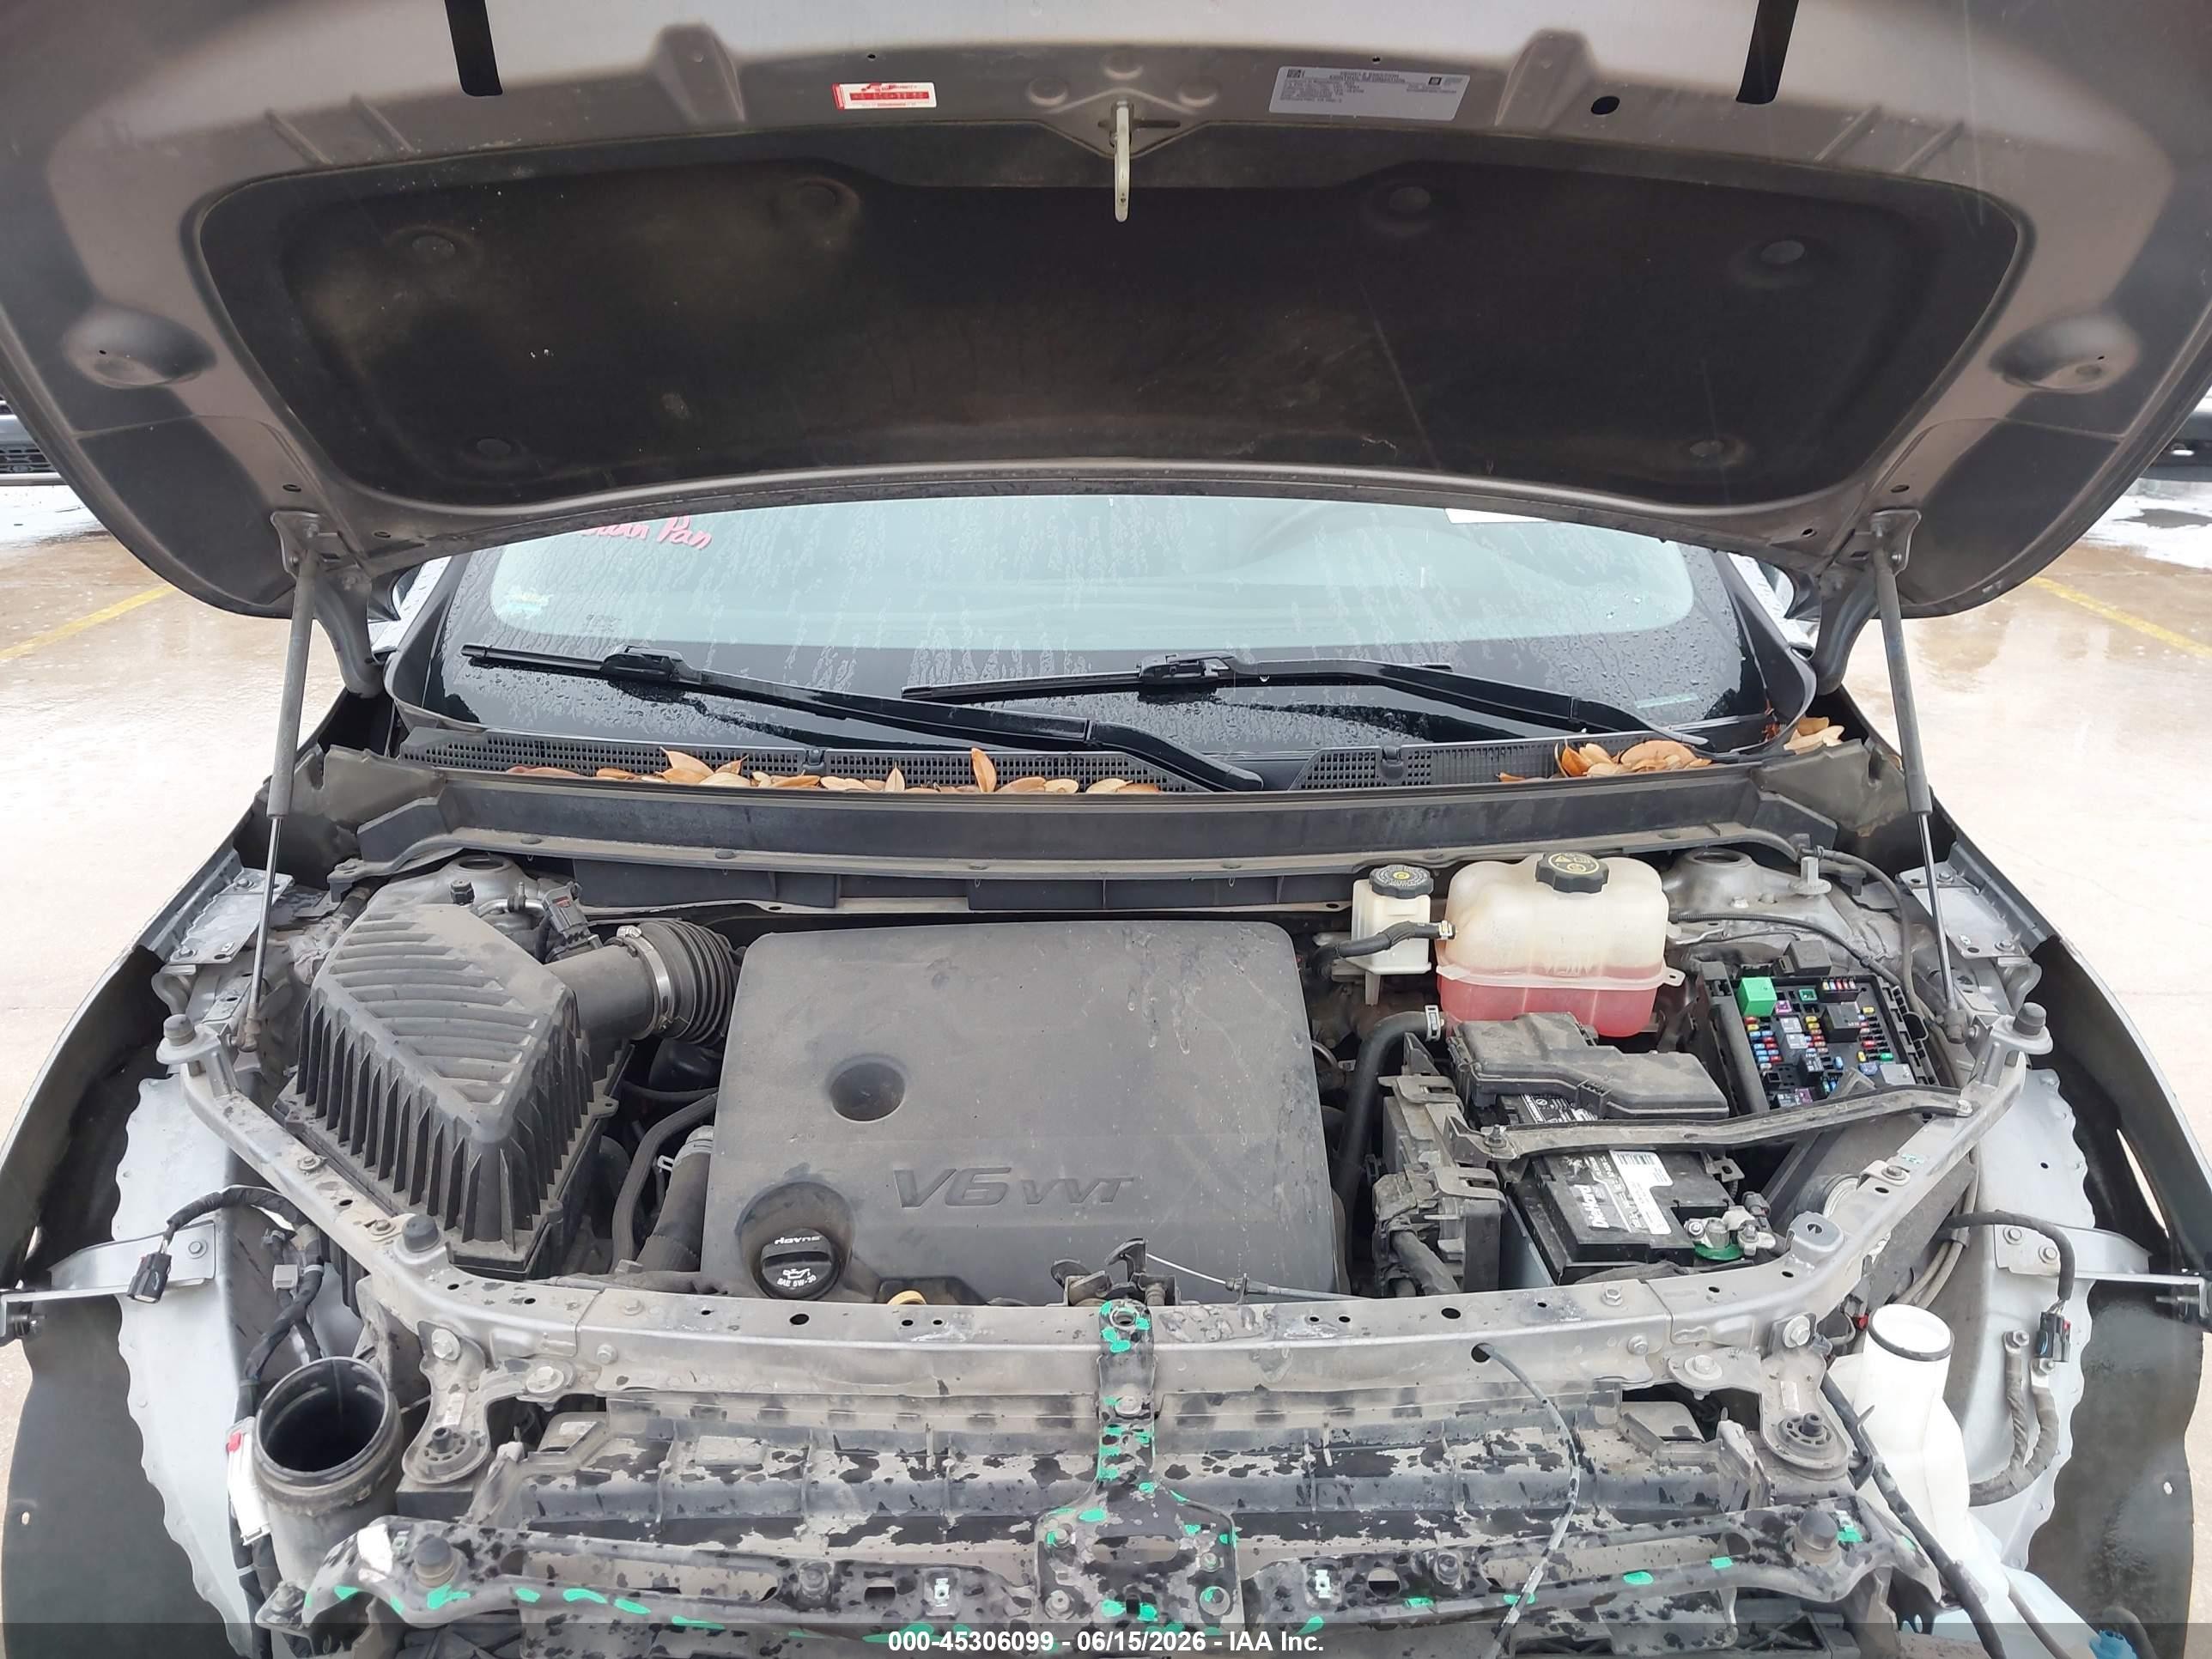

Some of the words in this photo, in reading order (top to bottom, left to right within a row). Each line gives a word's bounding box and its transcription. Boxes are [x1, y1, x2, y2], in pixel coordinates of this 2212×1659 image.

[657, 514, 712, 550] Pan
[893, 1167, 1012, 1208] V6
[1020, 1176, 1134, 1205] VVT
[1573, 1184, 1610, 1229] DieHard
[776, 1277, 792, 1287] SAE
[792, 1274, 817, 1287] 5W-30
